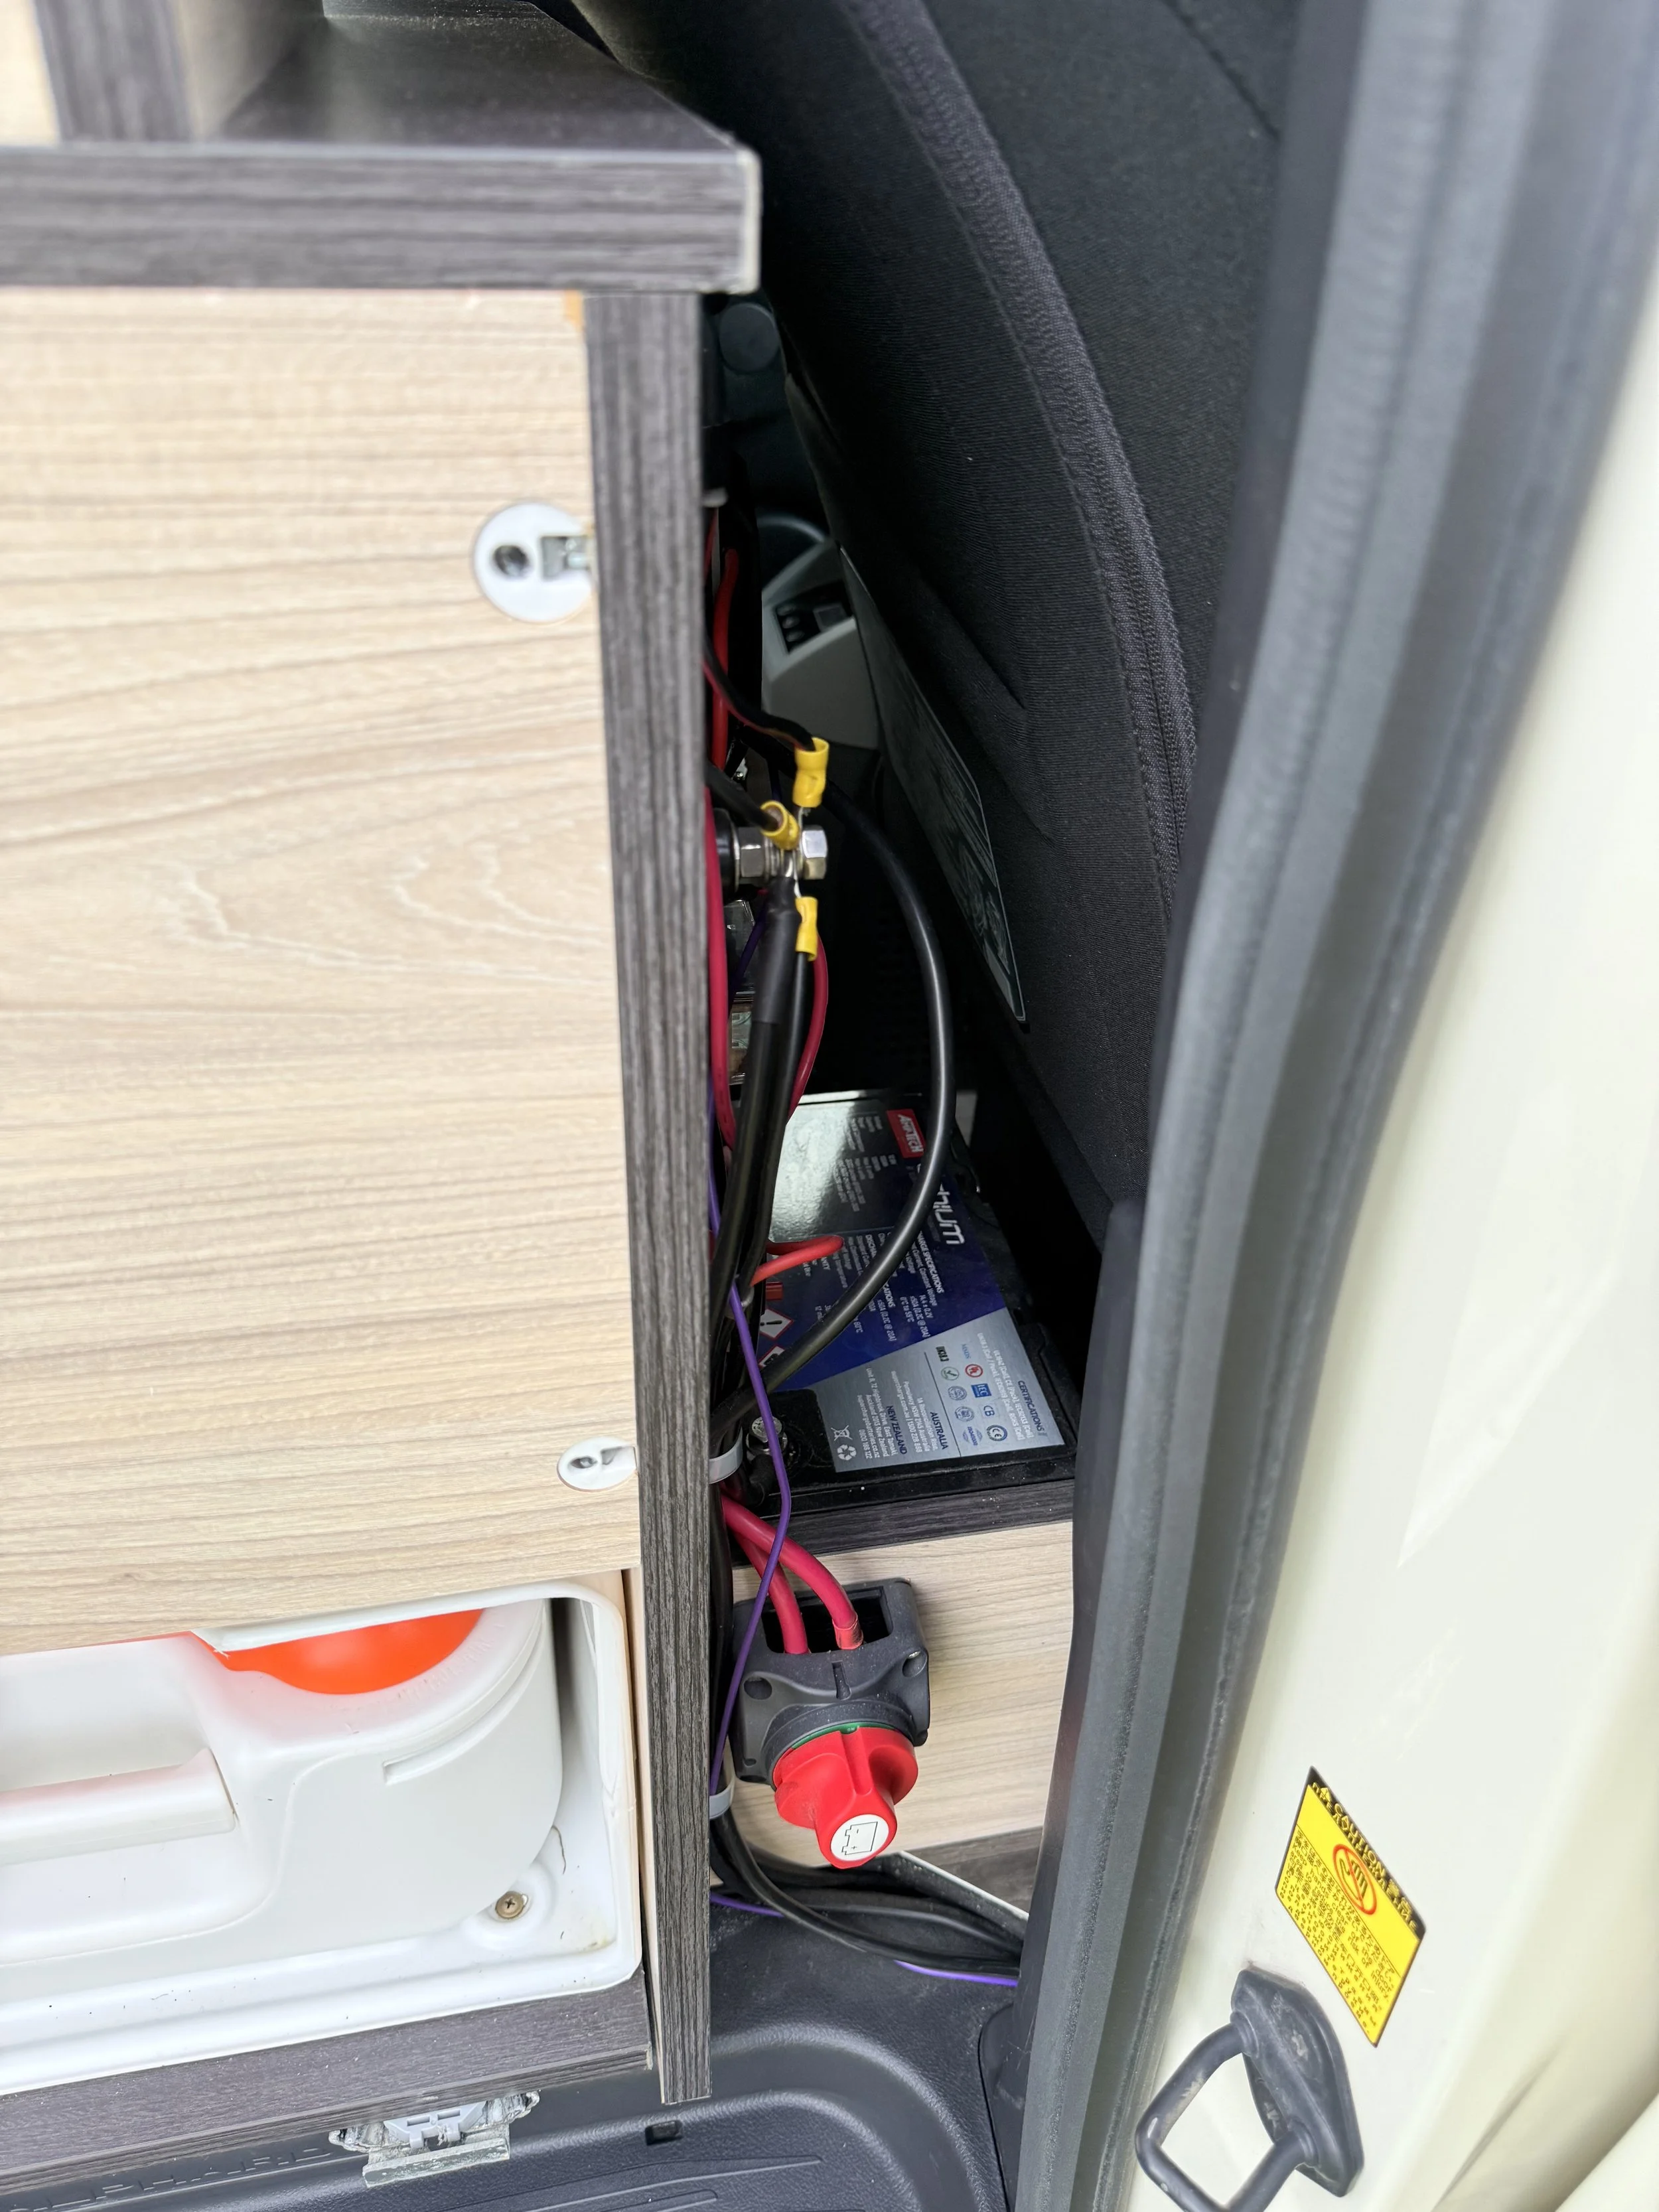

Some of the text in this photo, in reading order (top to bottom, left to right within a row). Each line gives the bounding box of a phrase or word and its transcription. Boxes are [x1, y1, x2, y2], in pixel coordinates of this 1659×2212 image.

[977, 1384, 988, 1396] IEC
[1017, 1380, 1044, 1431] CERTIFICATIONS
[856, 1394, 881, 1457] superchargebatteries.co.nz
[910, 1406, 919, 1417] NSW
[914, 1418, 923, 1428] 2145
[918, 1404, 935, 1437] Reconciliation
[982, 1405, 995, 1416] CB
[875, 1426, 885, 1437] New
[884, 1426, 893, 1436] East
[886, 1406, 908, 1454] NEW ZEALAND
[918, 1429, 930, 1451] Australia
[930, 1412, 948, 1449] AUSTRALIA
[991, 1428, 1002, 1438] CE
[879, 1438, 889, 1456] Zealand
[1333, 1800, 1385, 1878] CAUTION
[1312, 1779, 1417, 1934] ПРЕДУПРЕЖДЕНИЕ
[1291, 1841, 1392, 1995] Keep hands clear of the door
[1296, 1827, 1394, 1978] 手をはさむおそれがあるためドア
[1290, 1848, 1391, 2003] area to reduce the risk of injury.
